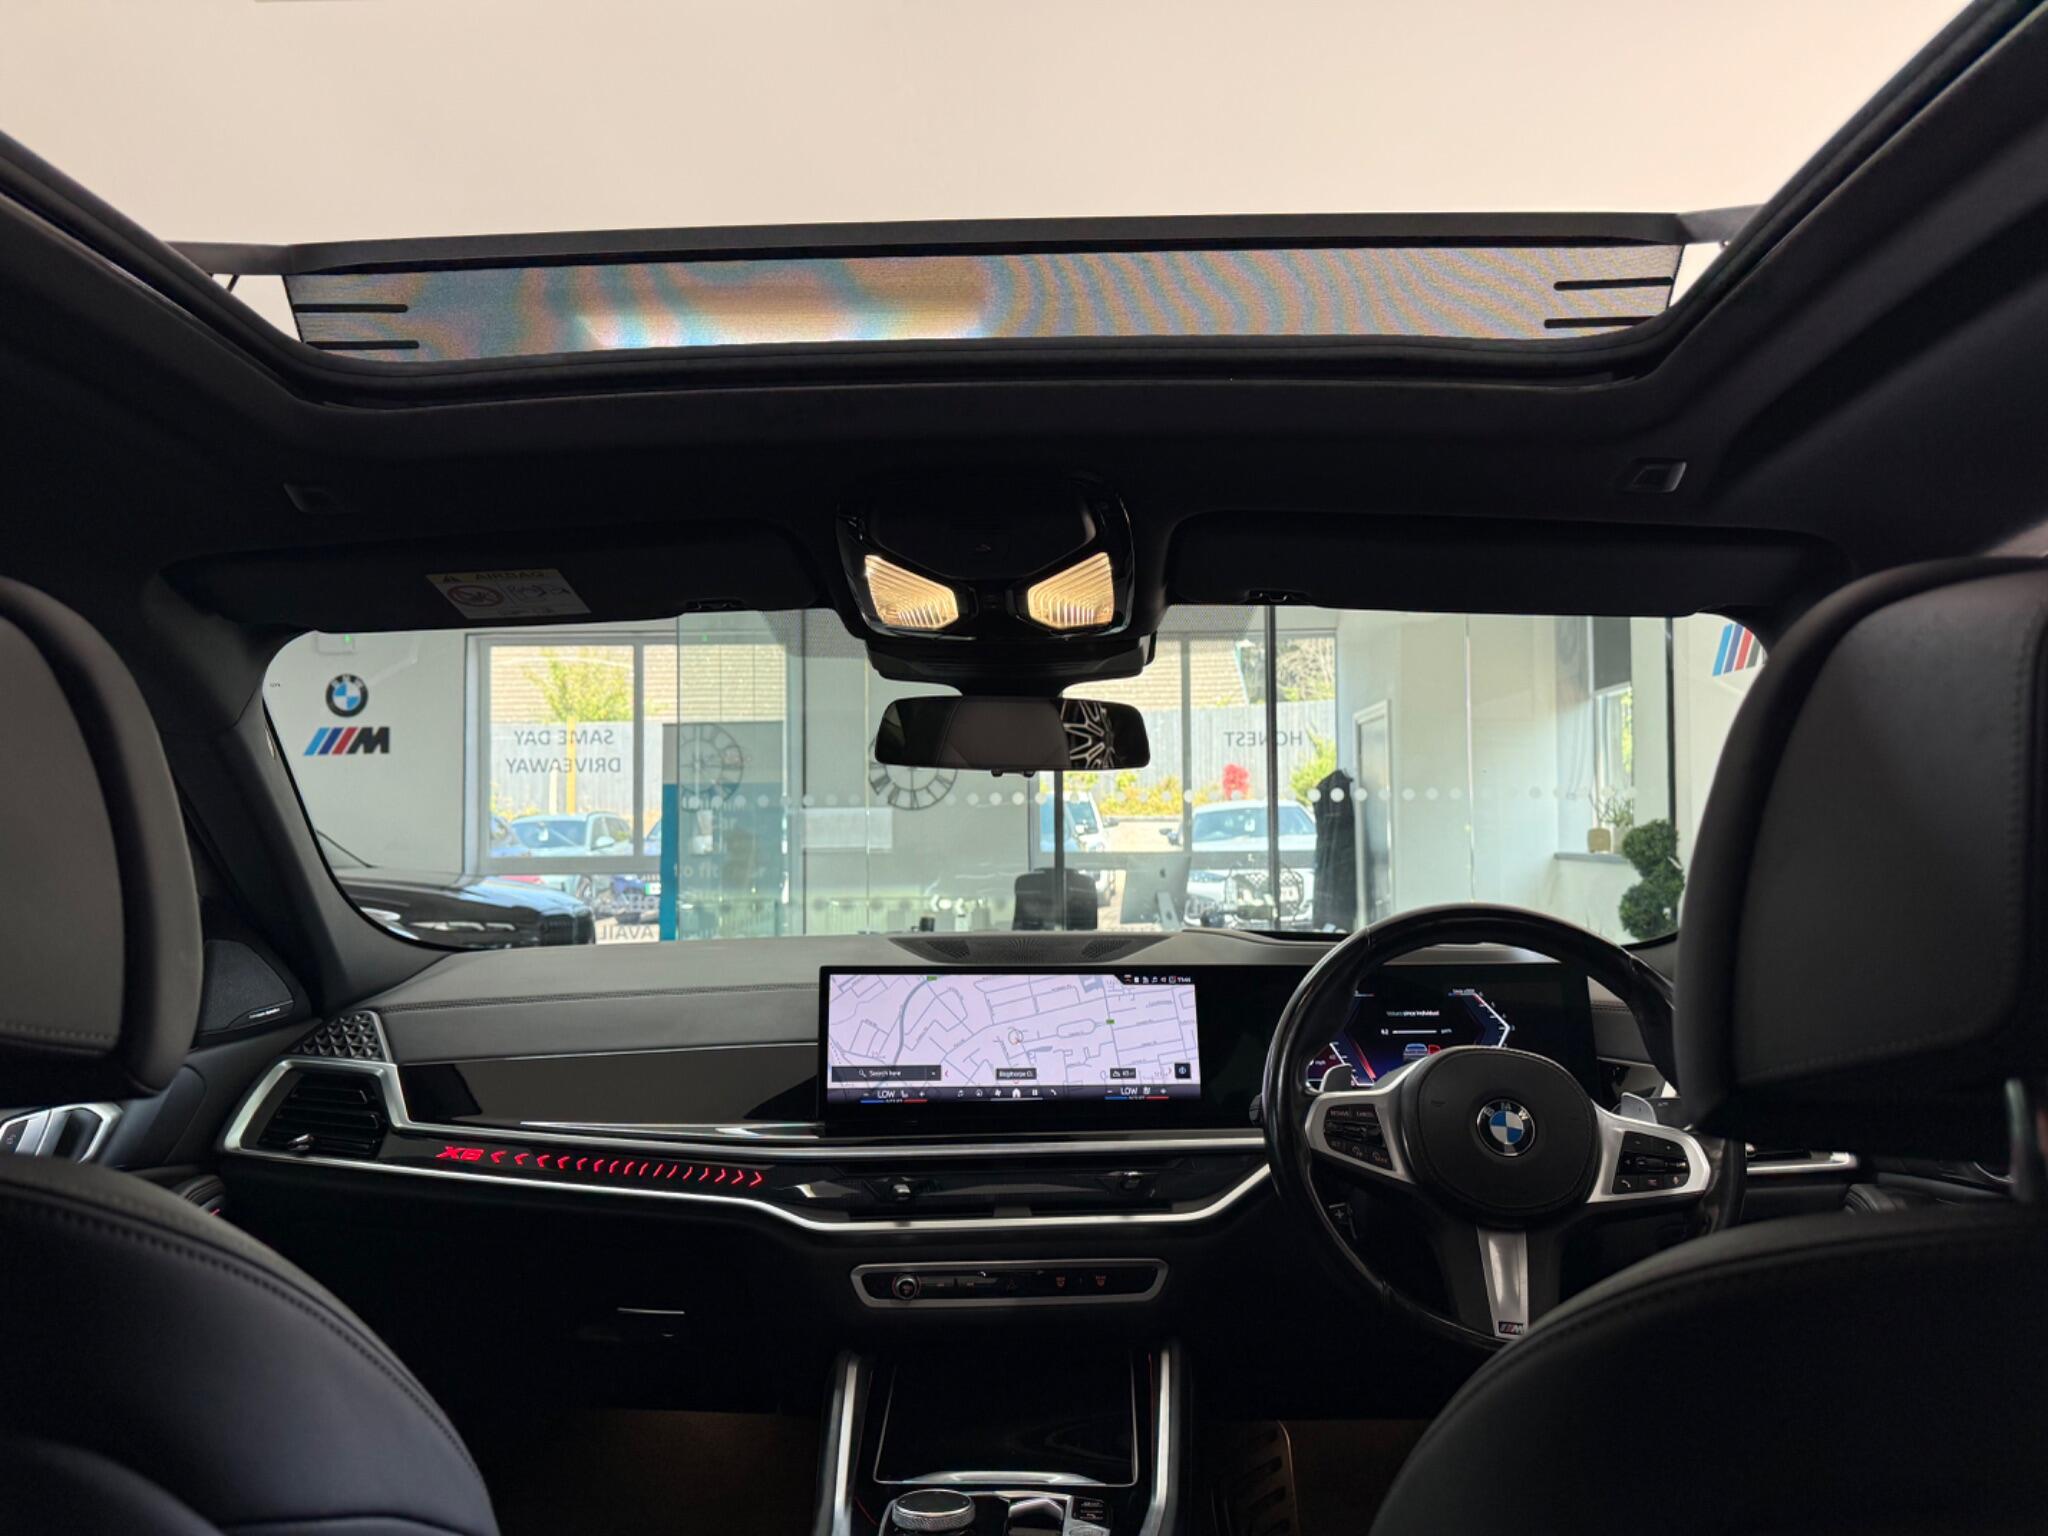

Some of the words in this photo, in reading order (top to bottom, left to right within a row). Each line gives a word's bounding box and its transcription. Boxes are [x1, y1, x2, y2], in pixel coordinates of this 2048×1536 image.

[474, 571, 546, 580] AIRBAG
[876, 1089, 896, 1099] LOW
[1119, 1086, 1138, 1095] LOW
